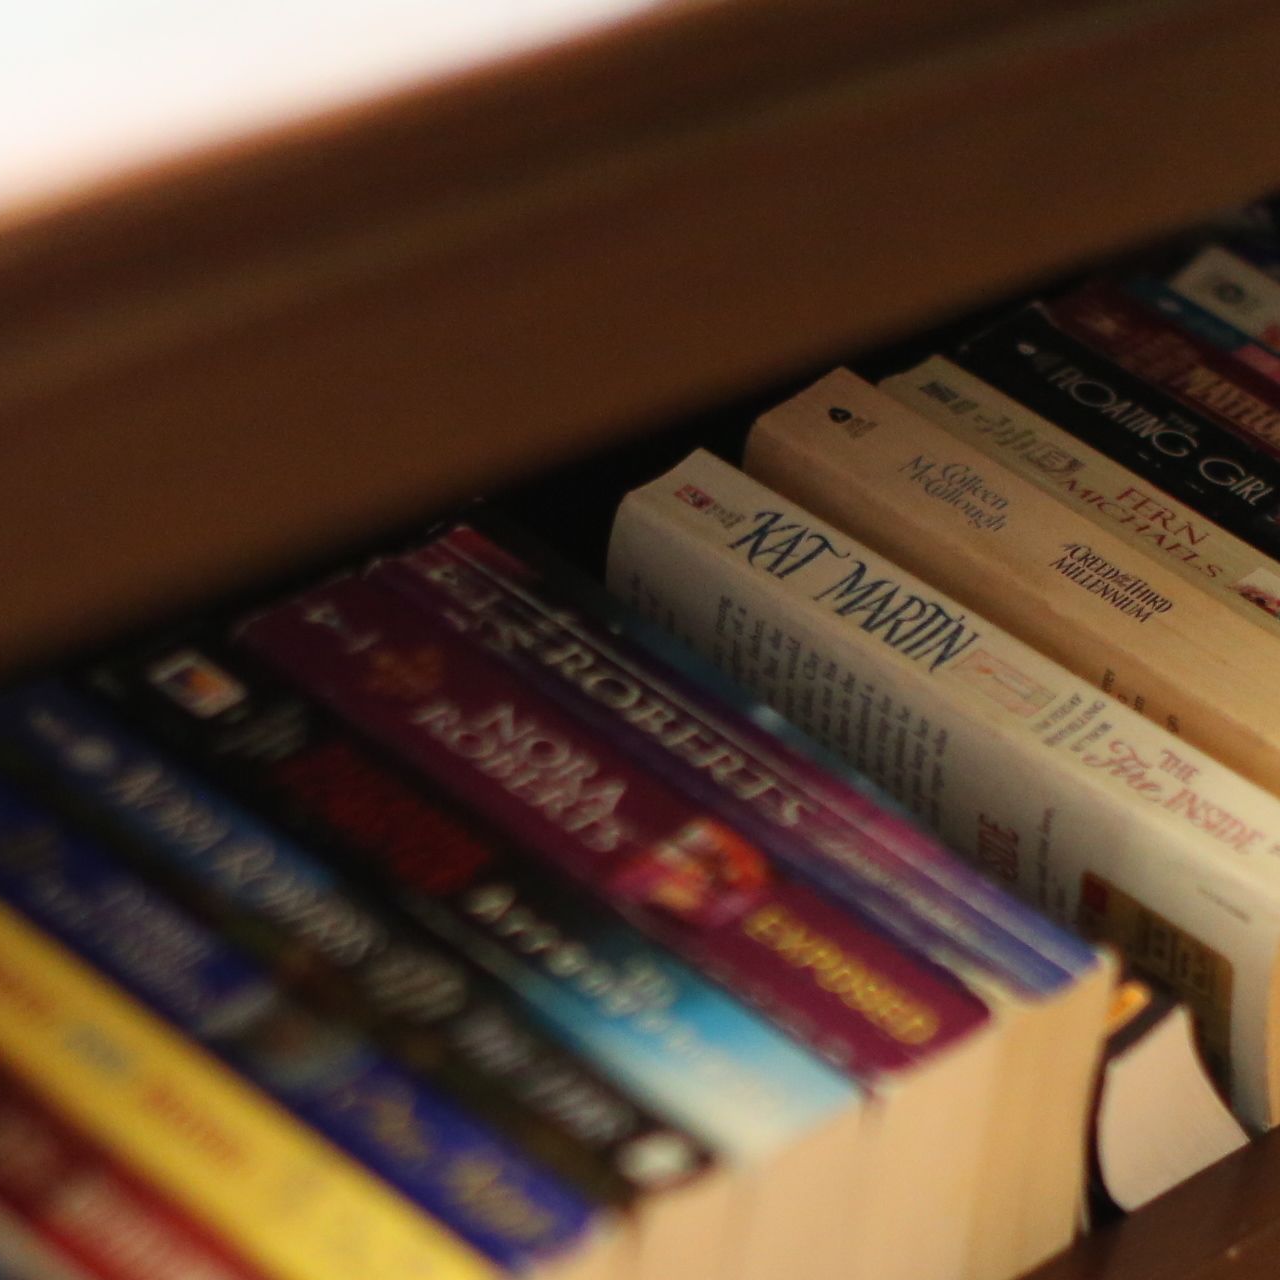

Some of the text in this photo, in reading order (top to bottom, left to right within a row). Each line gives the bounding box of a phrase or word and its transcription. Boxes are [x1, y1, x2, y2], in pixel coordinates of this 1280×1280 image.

[1048, 364, 1195, 459] FLOATING
[1198, 456, 1276, 507] GIRL
[899, 452, 1008, 537] McCullough
[938, 460, 1009, 511] Colleen
[1061, 478, 1225, 581] MICHAELS
[1114, 485, 1210, 547] FERN
[725, 509, 980, 675] KAT MARTIN
[1048, 553, 1158, 625] MILLENNIUM
[1069, 543, 1128, 584] CREED
[1123, 576, 1175, 615] THIRD
[412, 702, 632, 853] ROBERTS
[475, 702, 630, 824] NORA
[548, 647, 811, 828] ROBERTS
[1159, 746, 1202, 786] THE
